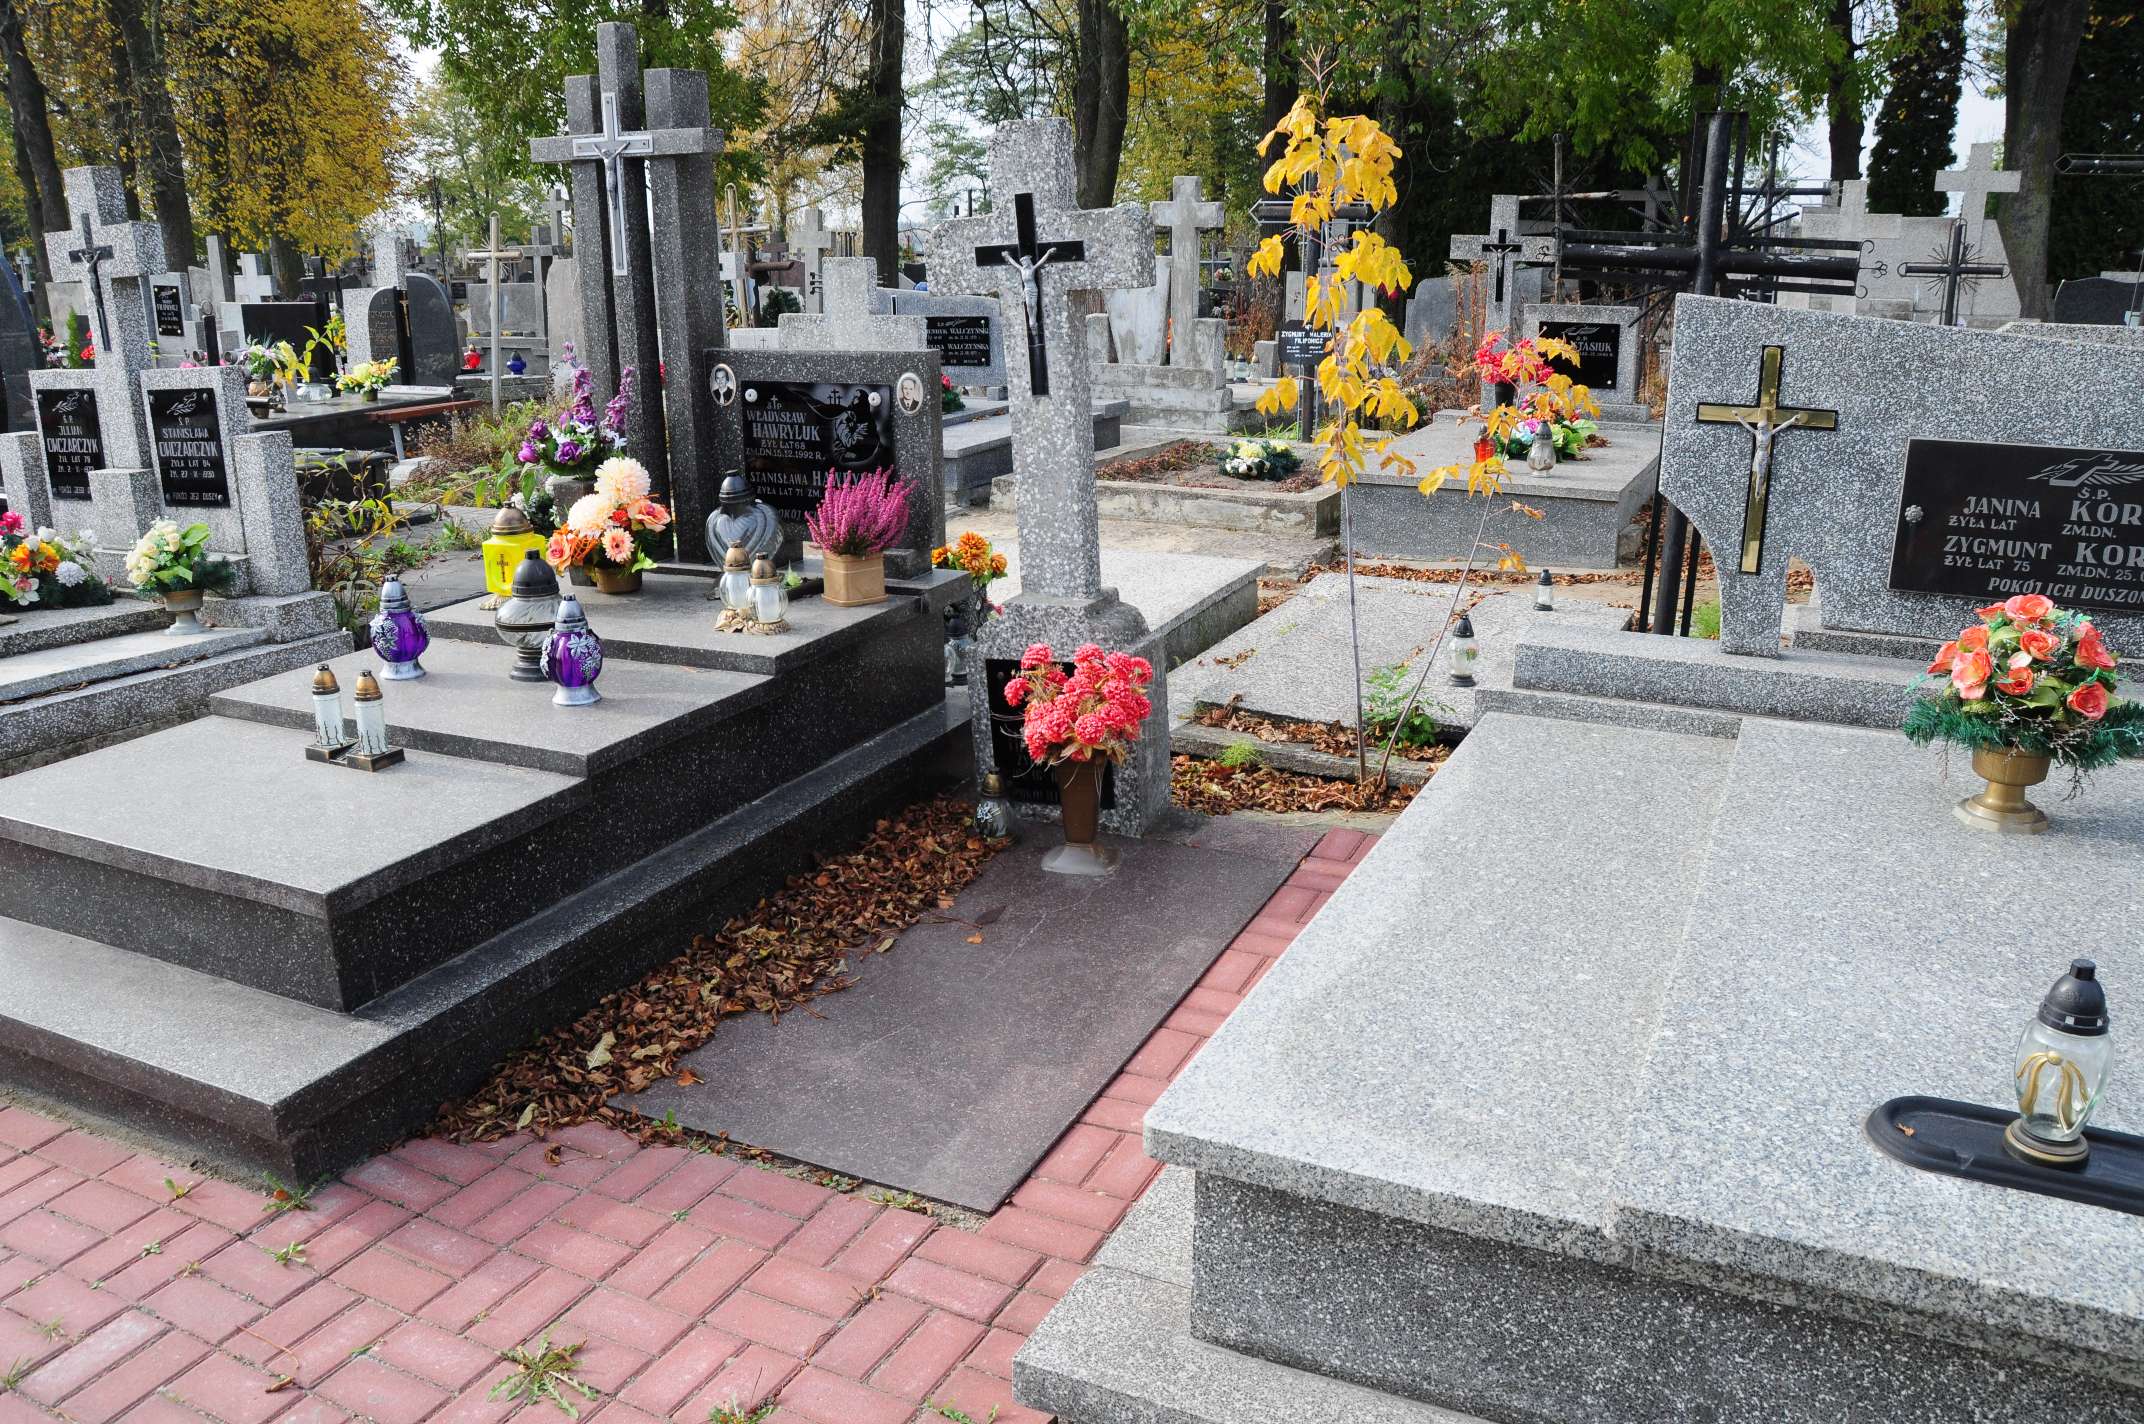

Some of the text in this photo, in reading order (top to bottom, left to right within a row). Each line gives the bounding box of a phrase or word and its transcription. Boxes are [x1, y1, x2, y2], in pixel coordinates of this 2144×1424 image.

[746, 409, 806, 424] WŁADYSŁAW
[752, 422, 821, 441] HAWRYLUK
[750, 471, 808, 485] STANISŁAWA
[1962, 496, 2041, 518] JANINA
[1948, 515, 1985, 530] ŻYŁA
[1990, 518, 2018, 532] LAT
[1944, 535, 2052, 560] ZYGMUNT
[1944, 554, 1973, 569] ŻYŁ
[1978, 557, 2004, 571] LAT
[2014, 560, 2031, 573] 75
[1988, 577, 2042, 597] POKÓJ
[2045, 582, 2076, 598] ICH
